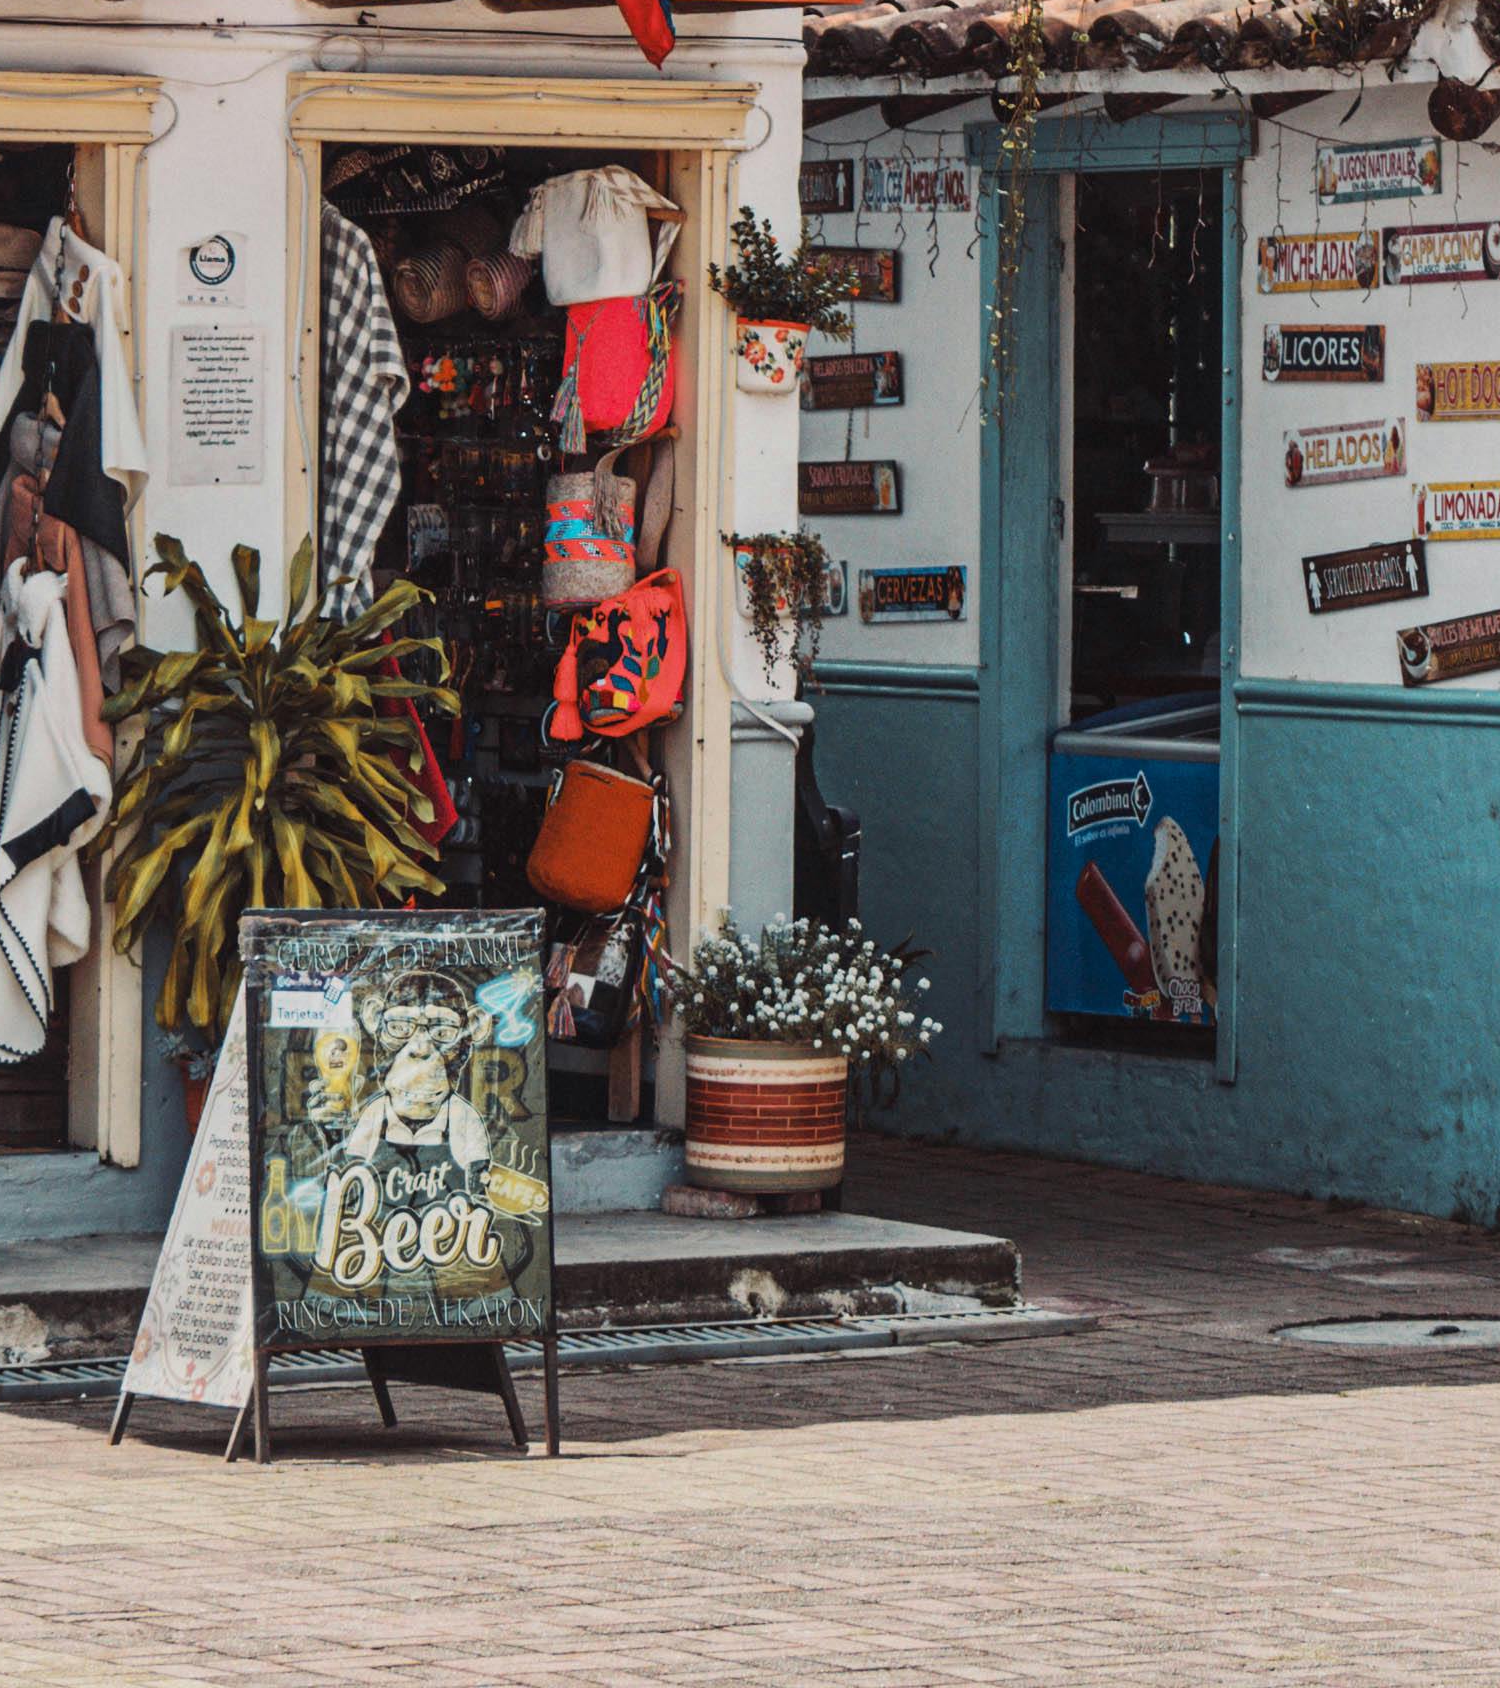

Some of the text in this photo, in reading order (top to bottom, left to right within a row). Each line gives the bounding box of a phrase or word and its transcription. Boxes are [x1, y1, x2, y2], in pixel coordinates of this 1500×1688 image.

[1368, 150, 1417, 178] NATURALES
[1277, 240, 1355, 282] MICHELADAS
[1402, 231, 1482, 266] CAPPUCCINO
[1284, 336, 1360, 366] LICORES
[1436, 367, 1467, 407] HOT
[1304, 432, 1382, 471] HELADOS
[876, 576, 943, 605] CERVEZAS
[1323, 552, 1405, 600] SERVICIO DE BAÑOS
[1073, 788, 1130, 821] Colombina
[277, 937, 390, 971] CERVEZA
[443, 932, 530, 966] BARRIL
[277, 1008, 325, 1022] Tarjetas
[386, 1163, 452, 1201] Craft
[315, 1164, 502, 1288] Beer
[379, 1296, 412, 1328] DE
